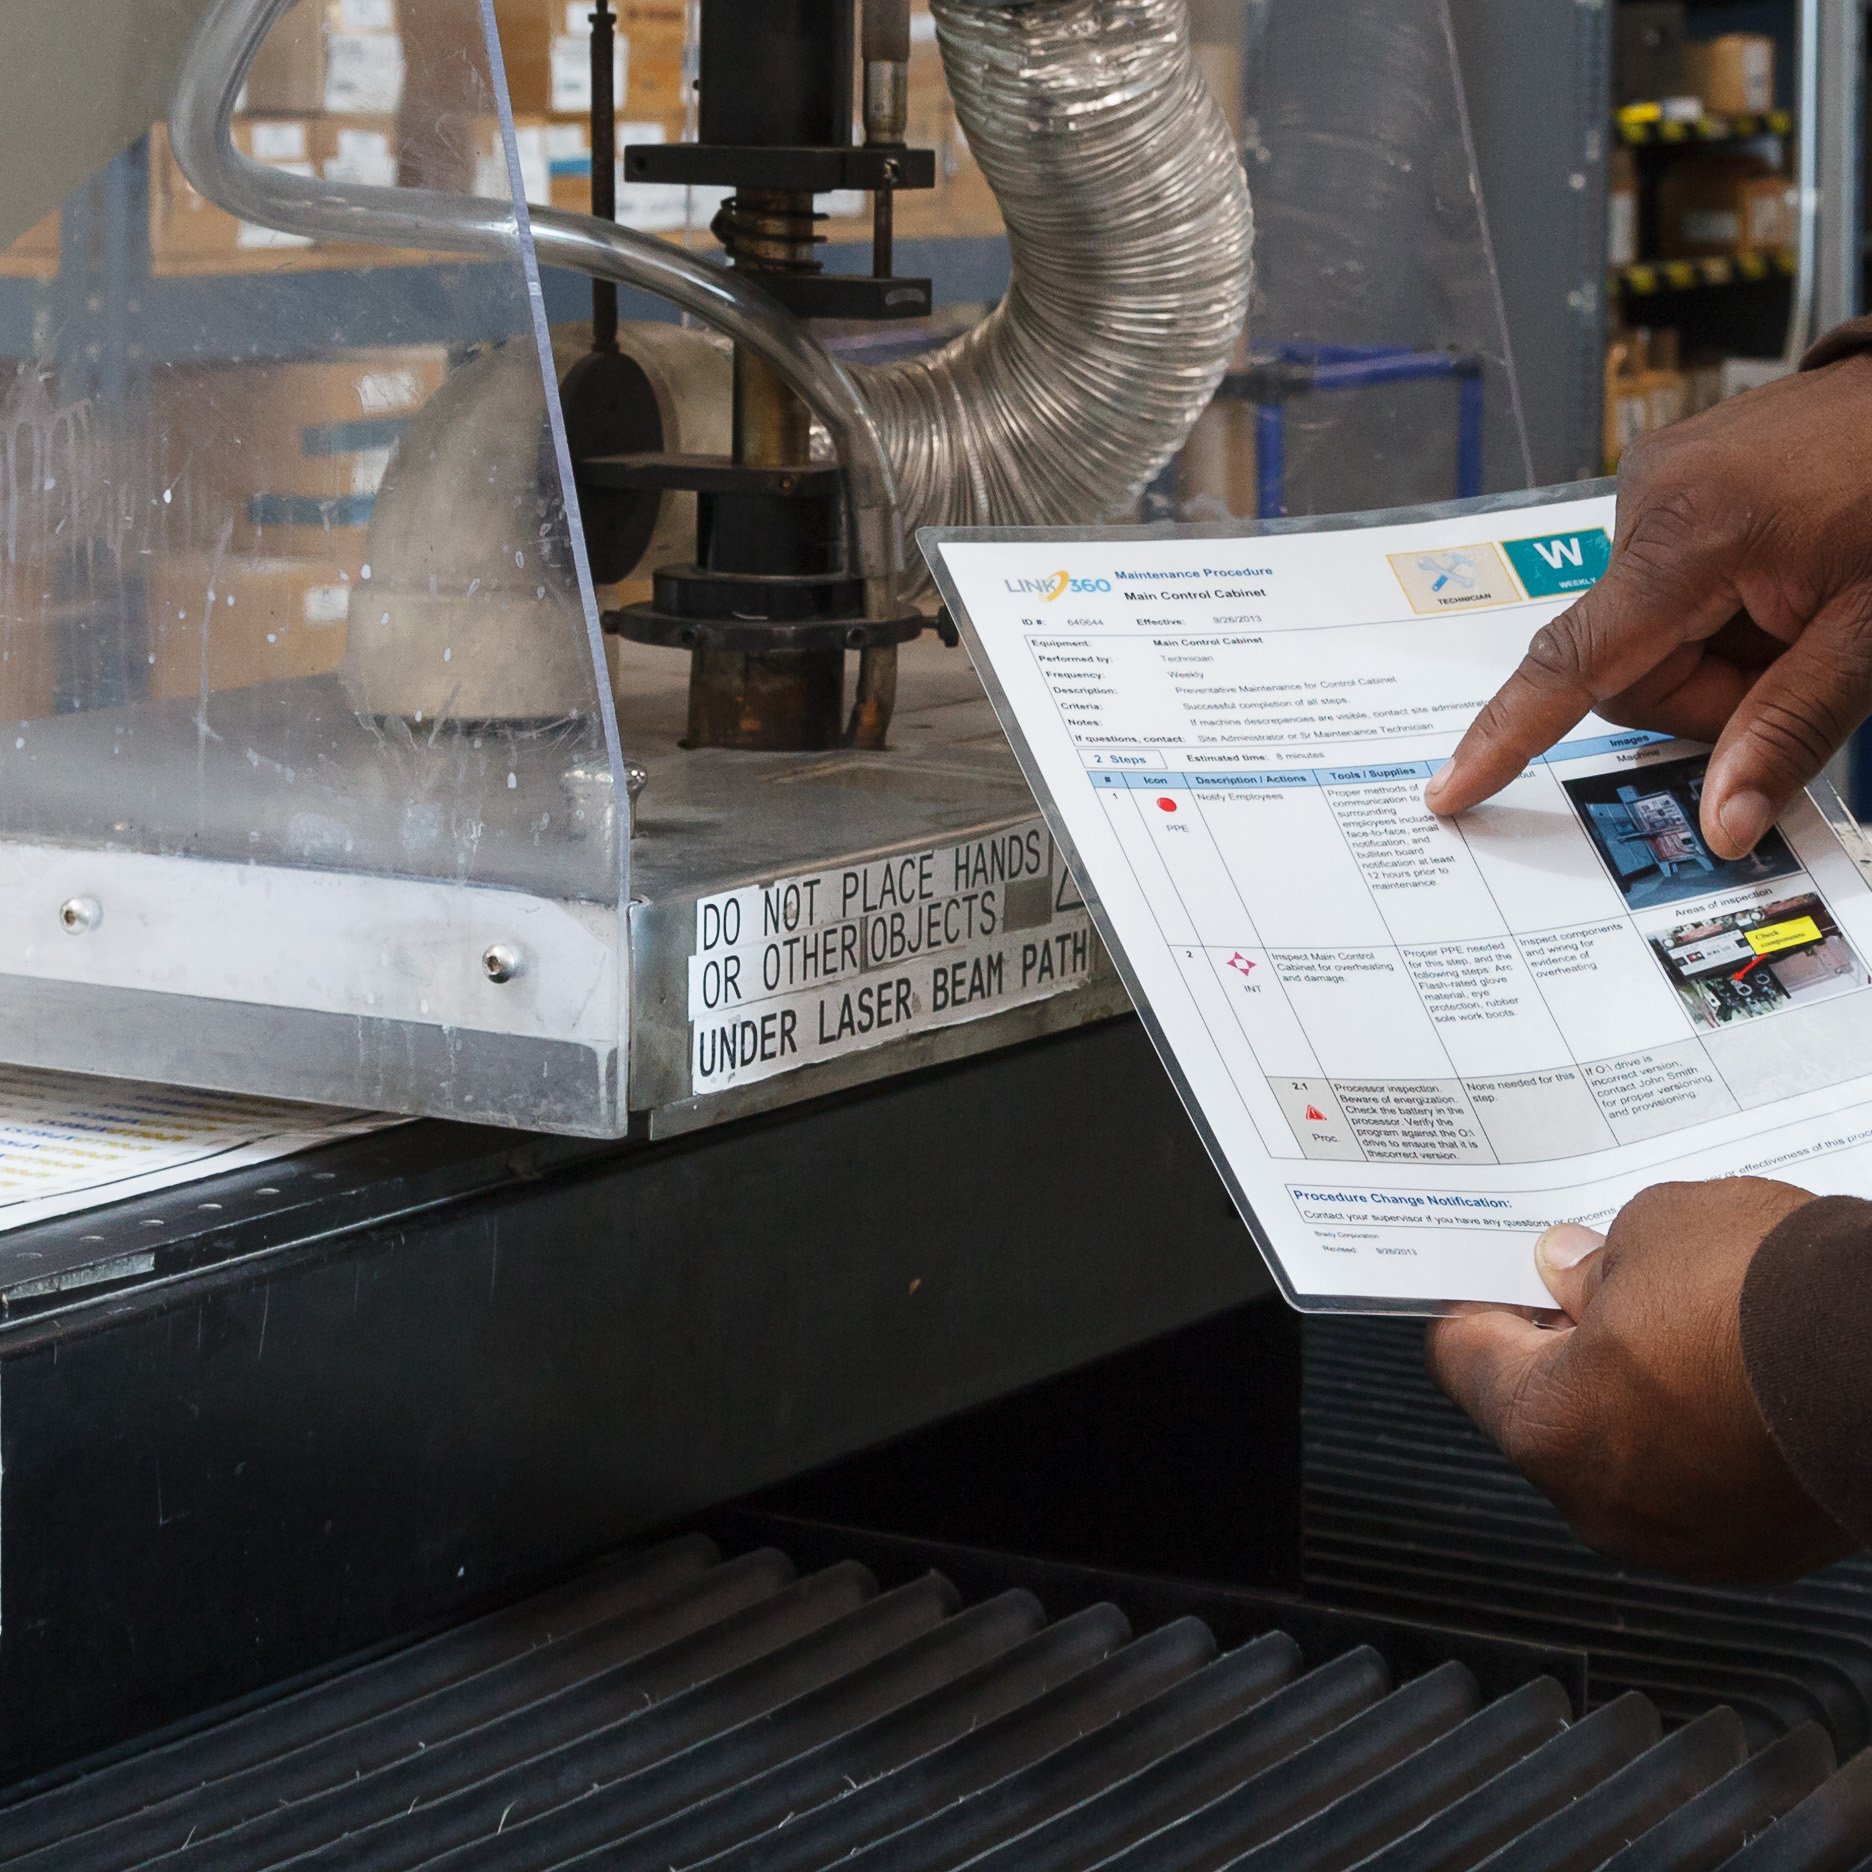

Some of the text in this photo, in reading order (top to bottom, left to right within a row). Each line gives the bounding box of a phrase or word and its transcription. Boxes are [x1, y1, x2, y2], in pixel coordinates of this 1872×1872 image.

[1533, 537, 1583, 570] W
[1203, 567, 1273, 578] Procedure
[1124, 588, 1266, 602] Main Control Cabinet
[1436, 592, 1492, 606] TECHNICIAN
[1031, 636, 1263, 648] Equipment: Main Control Cabinet
[1038, 654, 1214, 664] Performed by: Technician
[1046, 670, 1204, 680] Frequency: Weekly
[1053, 675, 1397, 696] Description: Preventative Maintenance for Control Cabinet
[1061, 702, 1103, 711] Criteria:
[1068, 718, 1103, 727] Notes:
[1075, 734, 1083, 743] If
[1085, 734, 1142, 745] questions,
[1144, 734, 1185, 744] contact:
[1198, 734, 1218, 743] Site
[1220, 732, 1285, 743] Administrator
[1287, 733, 1298, 741] or
[1314, 727, 1377, 739] Maintenance
[1380, 722, 1434, 736] Technician
[1095, 754, 1103, 764] 2
[1110, 755, 1147, 765] Steps
[1187, 753, 1239, 762] Estimated
[1242, 752, 1268, 761] time:
[1285, 751, 1325, 760] minutes
[1143, 734, 1650, 785] Icon Description Actions Tools Supplies Images
[1197, 792, 1284, 802] Notify Employees
[1166, 824, 1189, 833] PPE
[703, 829, 1041, 951] DO NOT PLACE HANDS
[1674, 888, 1773, 918] Areas of inspection
[1519, 923, 1623, 947] Inspect components
[703, 890, 996, 1009] OR OTHER OBJECTS
[1526, 939, 1595, 957] and wiring for
[1272, 953, 1308, 962] Inspect
[1338, 952, 1375, 960] Control
[1530, 951, 1590, 967] evidence of
[1277, 963, 1394, 972] Cabinet for overheating
[1536, 961, 1598, 979] overheating
[1283, 974, 1348, 984] and damage.
[1244, 985, 1262, 993] INT
[699, 930, 1088, 1078] UNDER LASER BEAM PATH
[1292, 1082, 1441, 1094] 2.1 Processor inspection.
[1466, 1071, 1575, 1092] None needed for this
[1340, 1095, 1458, 1105] Beware of energization.
[1472, 1093, 1498, 1104] step.
[1345, 1106, 1464, 1117] Check the battery in the
[1312, 1133, 1339, 1143] Proc.
[1294, 1189, 1513, 1210] Procedure Change Notification:
